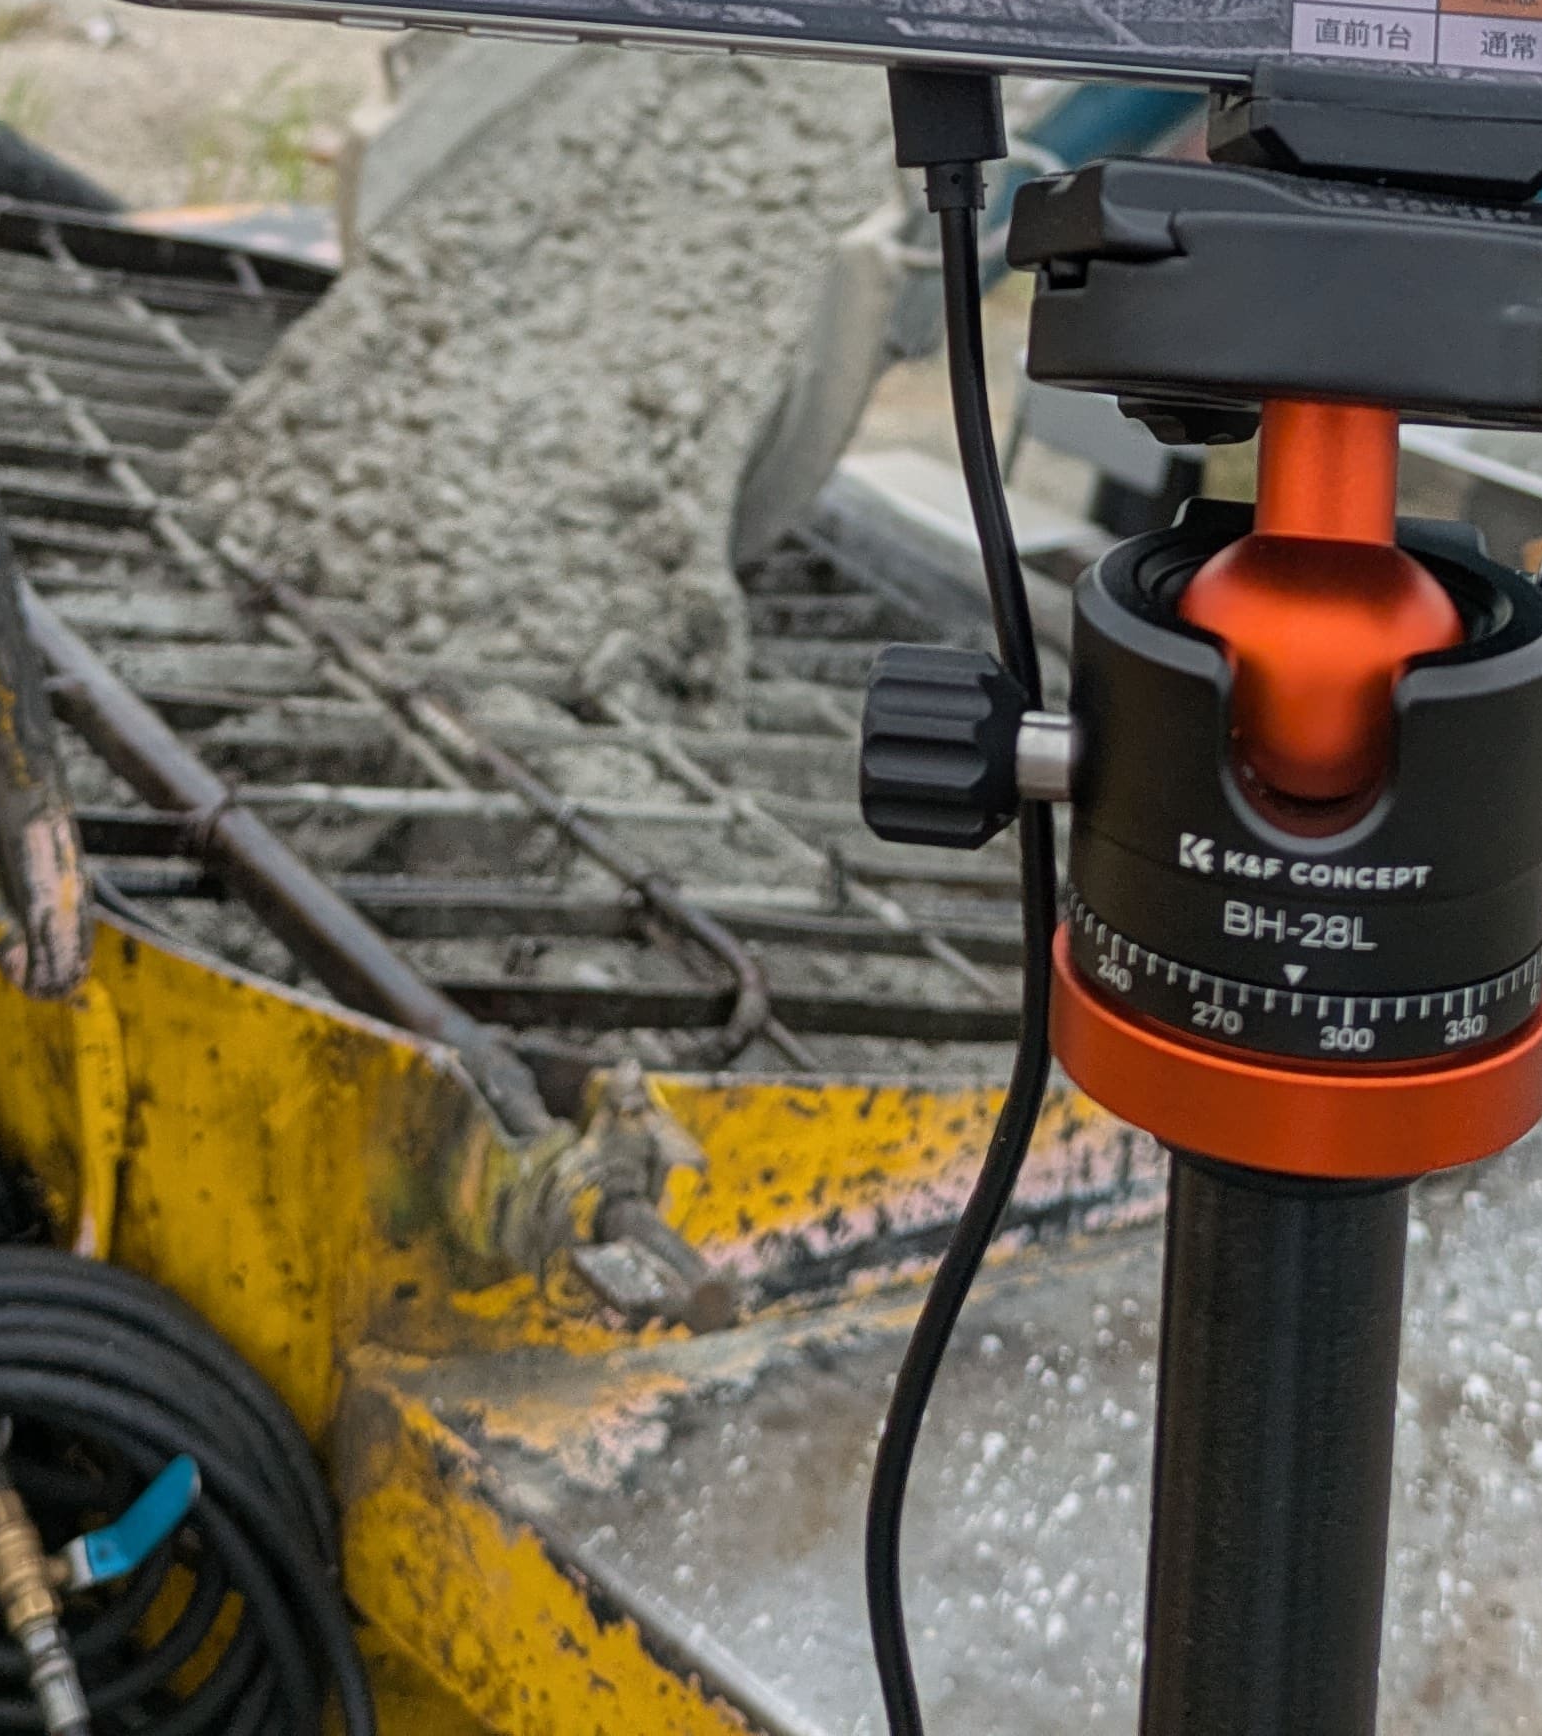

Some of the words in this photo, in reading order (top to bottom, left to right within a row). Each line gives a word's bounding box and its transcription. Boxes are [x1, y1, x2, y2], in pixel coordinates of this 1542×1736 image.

[1315, 17, 1412, 52] 直前1台
[1480, 29, 1537, 61] 通常
[1223, 850, 1284, 881] K&F
[1289, 862, 1433, 890] CONCEPT
[1223, 900, 1378, 951] BH-28L
[1097, 954, 1133, 993] 240
[1191, 1001, 1244, 1035] 270
[1320, 1025, 1376, 1052] 300
[1443, 1014, 1488, 1046] 330
